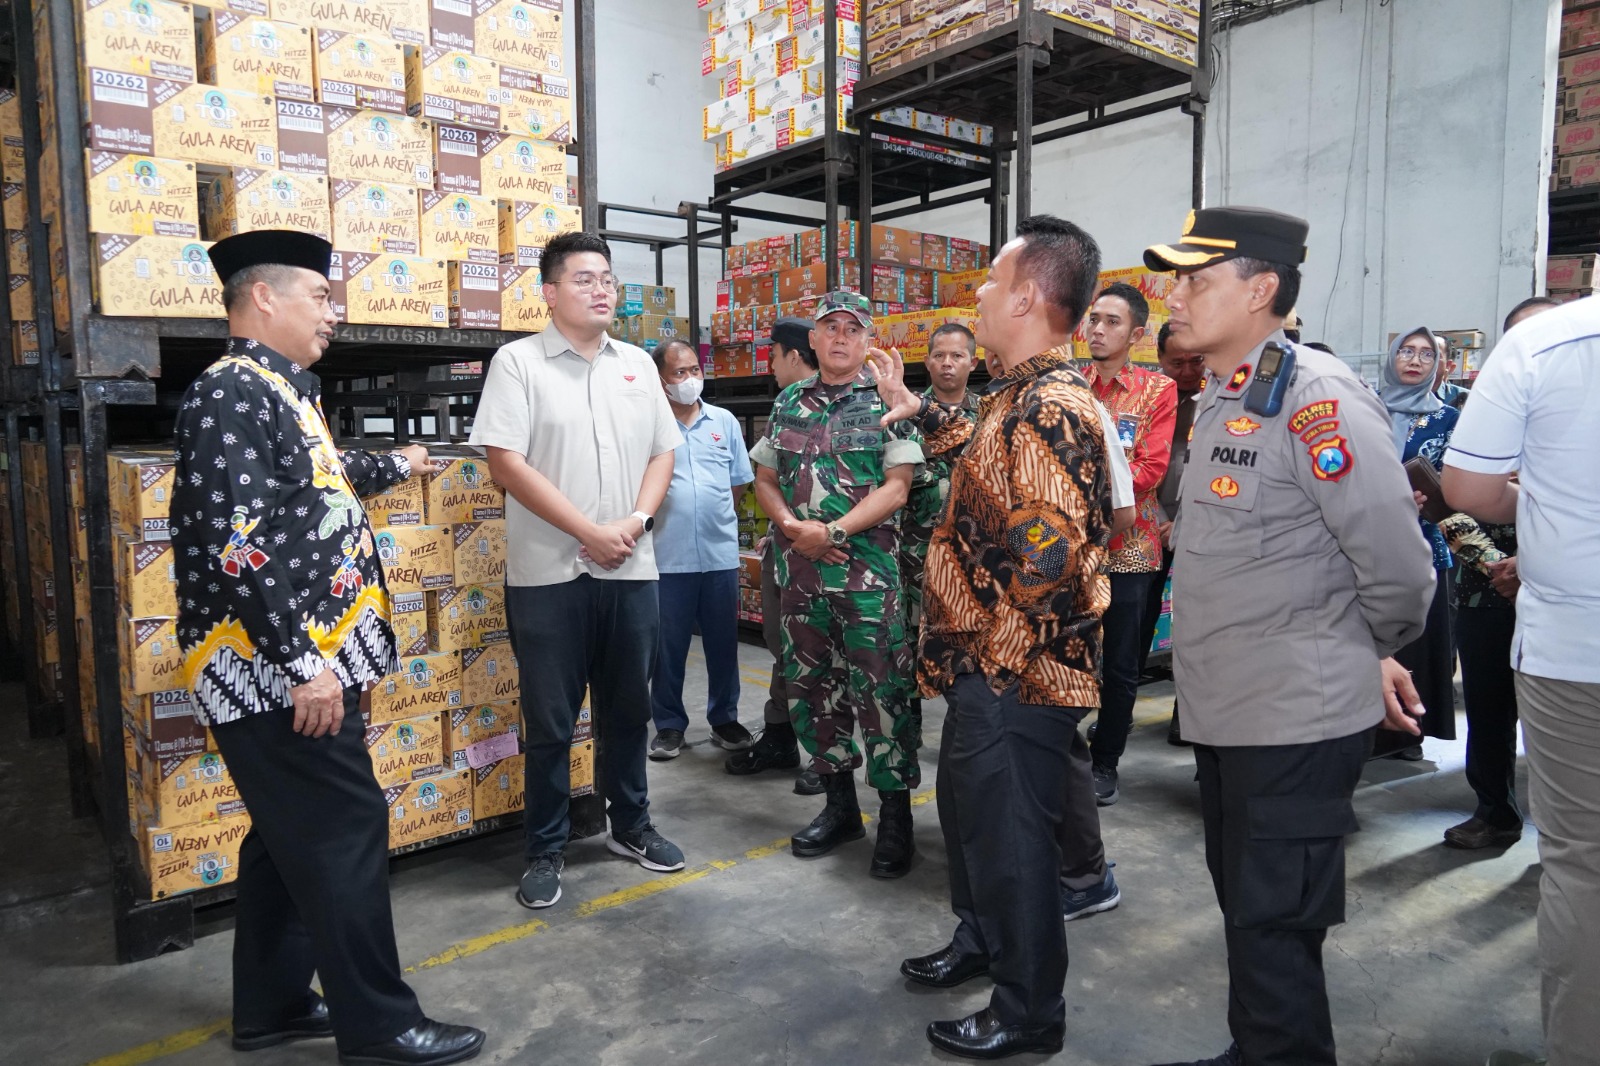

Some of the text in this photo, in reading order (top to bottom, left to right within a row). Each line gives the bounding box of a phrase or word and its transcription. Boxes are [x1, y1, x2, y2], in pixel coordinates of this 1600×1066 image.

[311, 1, 392, 31] GULA AREN
[536, 32, 558, 40] HITZZ
[105, 34, 181, 60] GULA AREN
[493, 38, 518, 52] GULA
[521, 42, 548, 61] AREN
[270, 61, 300, 80] AREN
[550, 60, 559, 68] 10
[95, 71, 145, 90] 20262
[364, 71, 385, 83] AREN
[394, 78, 403, 86] 10
[323, 81, 354, 94] 20262
[444, 85, 480, 98] GULA AREN
[544, 85, 568, 97] 20262
[426, 96, 453, 109] 20262
[489, 94, 498, 102] 10
[195, 103, 238, 121] TOP
[279, 102, 321, 118] 20262
[241, 119, 270, 128] HITZZ
[364, 129, 398, 145] TOP
[441, 128, 475, 142] 20262
[180, 131, 256, 155] GULA AREN
[401, 140, 426, 150] HITZZ
[260, 153, 271, 161] 10
[349, 154, 414, 173] GULA AREN
[509, 152, 539, 167] TOP
[418, 171, 428, 179] 10
[541, 163, 563, 173] HITZZ
[124, 173, 166, 190] TOP
[498, 176, 553, 194] GULA AREN
[166, 187, 193, 195] HITZZ
[555, 191, 563, 199] 10
[110, 199, 184, 219] GULA AREN
[301, 199, 323, 207] HITZZ
[251, 212, 317, 229] GULA AREN
[393, 209, 413, 217] HITZZ
[348, 221, 407, 238] GULA AREN
[477, 218, 496, 227] HITZZ
[435, 231, 490, 246] GULA AREN
[171, 260, 215, 277] TOP
[464, 264, 497, 277] 20262
[1098, 272, 1110, 280] arga
[381, 273, 416, 288] TOP
[418, 280, 443, 292] HITZZ
[150, 287, 223, 308] GULA AR
[651, 295, 668, 304] TOP
[368, 298, 431, 315] GULA AREN
[518, 307, 542, 321] GULA
[434, 311, 444, 319] 10
[657, 327, 678, 338] TOP
[907, 330, 929, 341] YUMIE
[842, 416, 871, 428] TNI AD
[1292, 402, 1334, 428] POLRES
[1296, 409, 1333, 431] MADIUN
[1211, 446, 1258, 468] POLRI
[454, 473, 482, 484] TOP
[397, 482, 417, 492] HITZZ
[384, 498, 412, 510] AREN
[443, 493, 495, 507] GULA AREN
[145, 520, 170, 531] 2026
[456, 530, 472, 545] EXTRA
[410, 541, 437, 557] HITZZ
[137, 552, 160, 569] EXTRA
[387, 568, 423, 584] AREN
[396, 601, 423, 612] 20262
[462, 599, 490, 612] TOP
[451, 617, 502, 635] GULA AREN
[153, 658, 184, 676] GULA
[403, 668, 434, 685] TOP
[437, 668, 458, 683] HITZZ
[495, 679, 519, 696] GUL
[155, 690, 190, 704] 2026
[390, 690, 447, 712] GULA AREN
[450, 696, 459, 704] 10
[476, 715, 497, 727] TOP
[368, 731, 382, 746] EXTRA
[391, 735, 419, 749] TOP
[421, 735, 438, 746] HITZZ
[379, 757, 406, 775] GULA
[408, 752, 433, 767] AREN
[192, 764, 227, 781] TOP
[177, 788, 208, 808] GULA
[412, 793, 442, 809] TOP
[445, 788, 466, 804] HITZZ
[400, 810, 456, 836] GULA AREN
[157, 838, 169, 846] 10
[174, 825, 246, 852] GULA AREN
[158, 860, 189, 878] HITZZ
[192, 856, 232, 875] TOP
